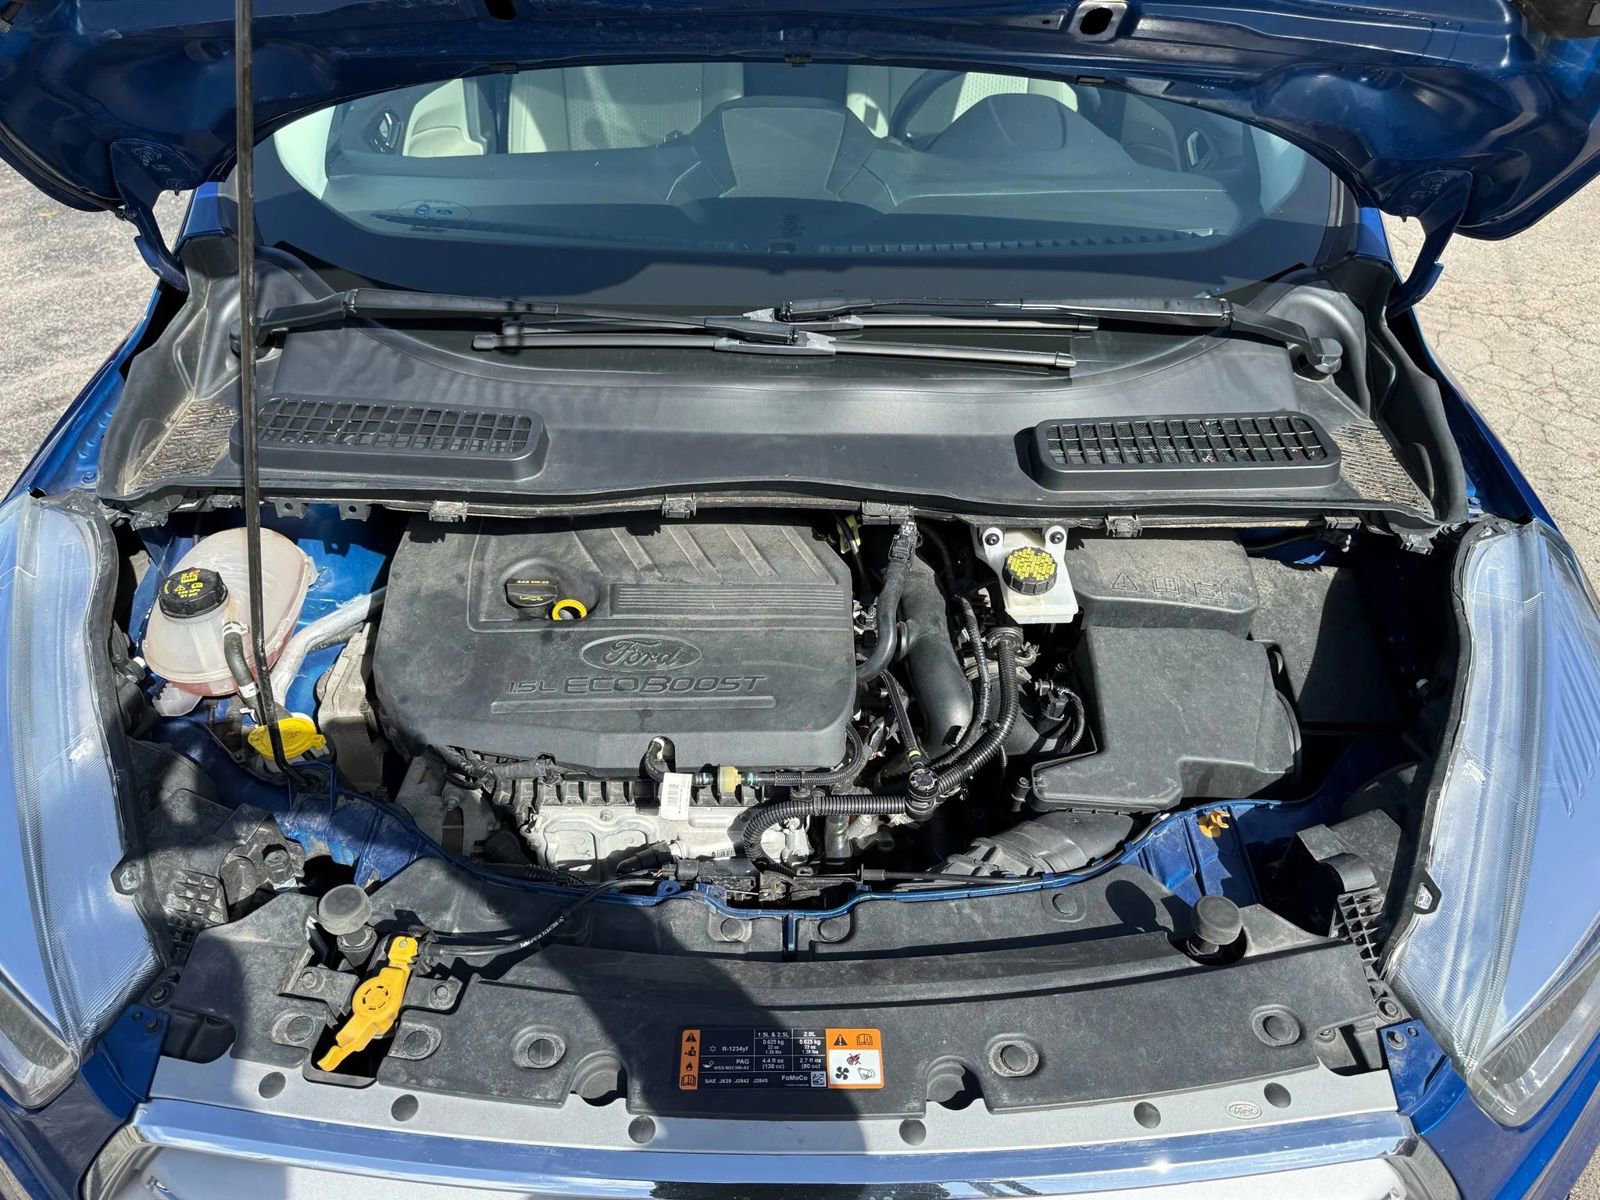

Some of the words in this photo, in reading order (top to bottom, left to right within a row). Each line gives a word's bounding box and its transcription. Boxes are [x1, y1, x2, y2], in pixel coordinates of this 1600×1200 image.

[602, 639, 684, 667] Ford
[508, 680, 556, 694] 1.5L
[564, 675, 767, 694] ECOBOOST
